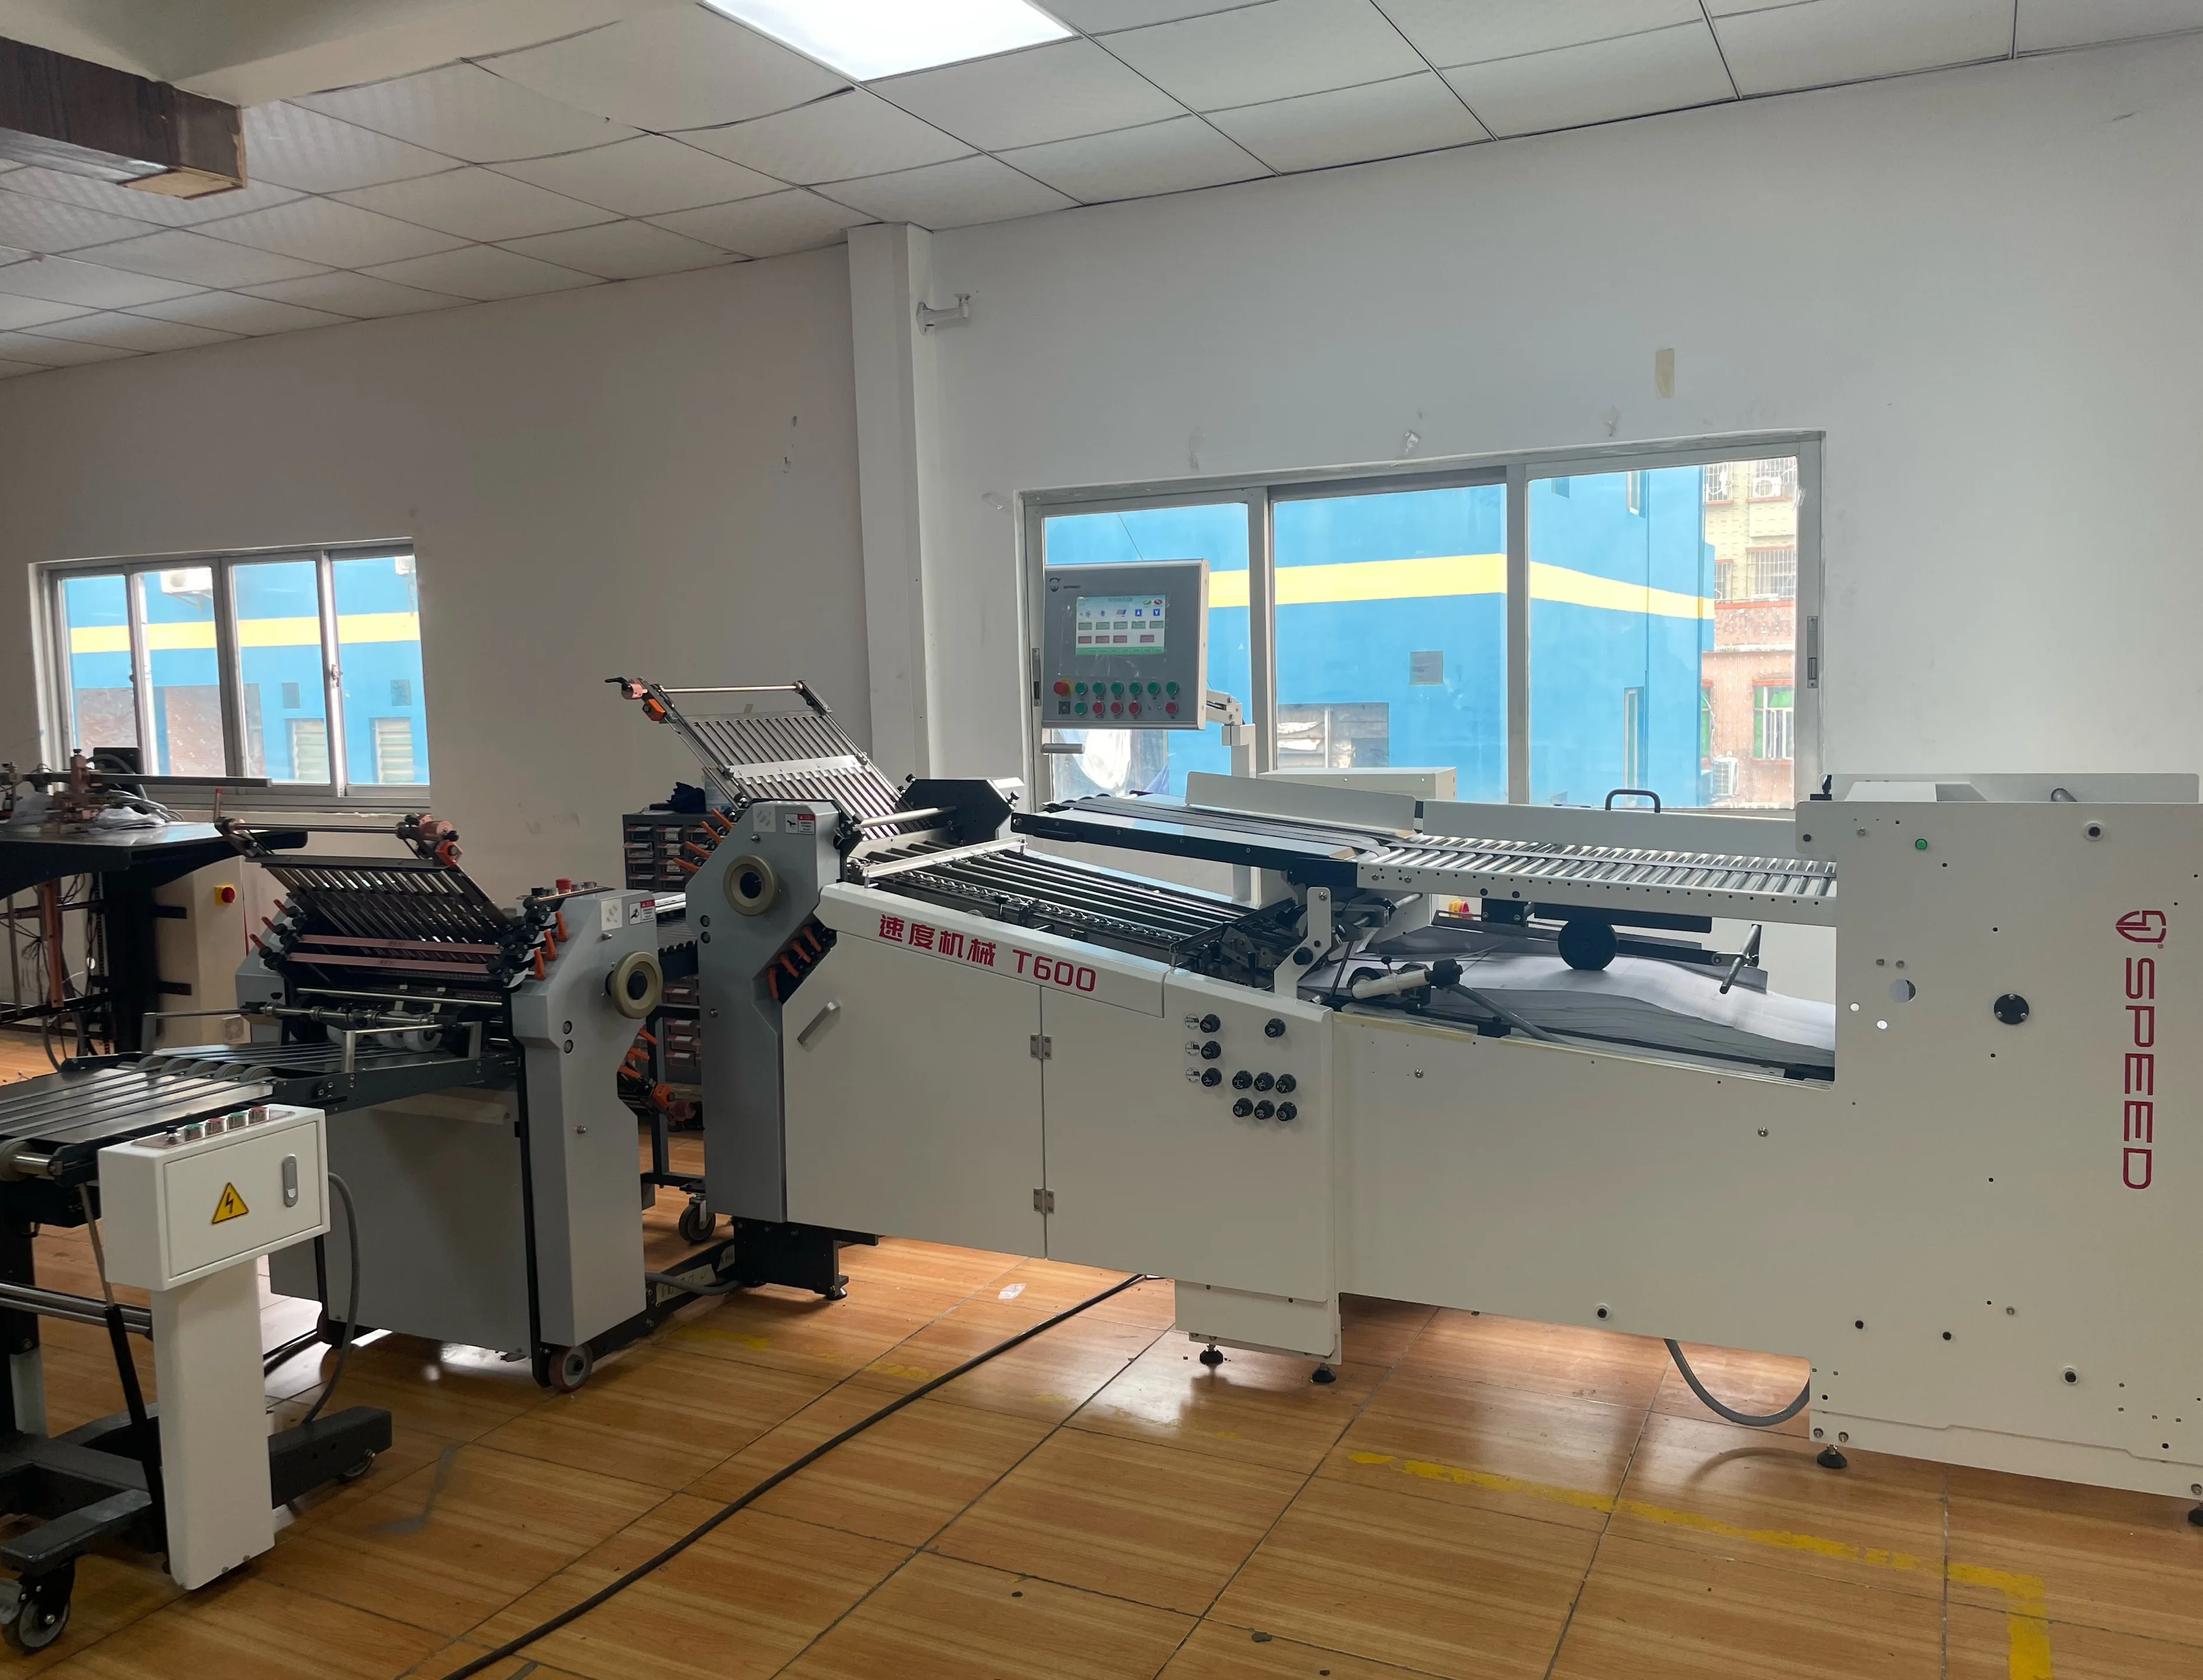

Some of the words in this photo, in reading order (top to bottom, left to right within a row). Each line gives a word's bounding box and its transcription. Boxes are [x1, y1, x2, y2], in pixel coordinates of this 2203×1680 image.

[879, 915, 996, 967] 速度机械
[1013, 949, 1096, 992] T600
[2123, 958, 2155, 1189] SPEED
